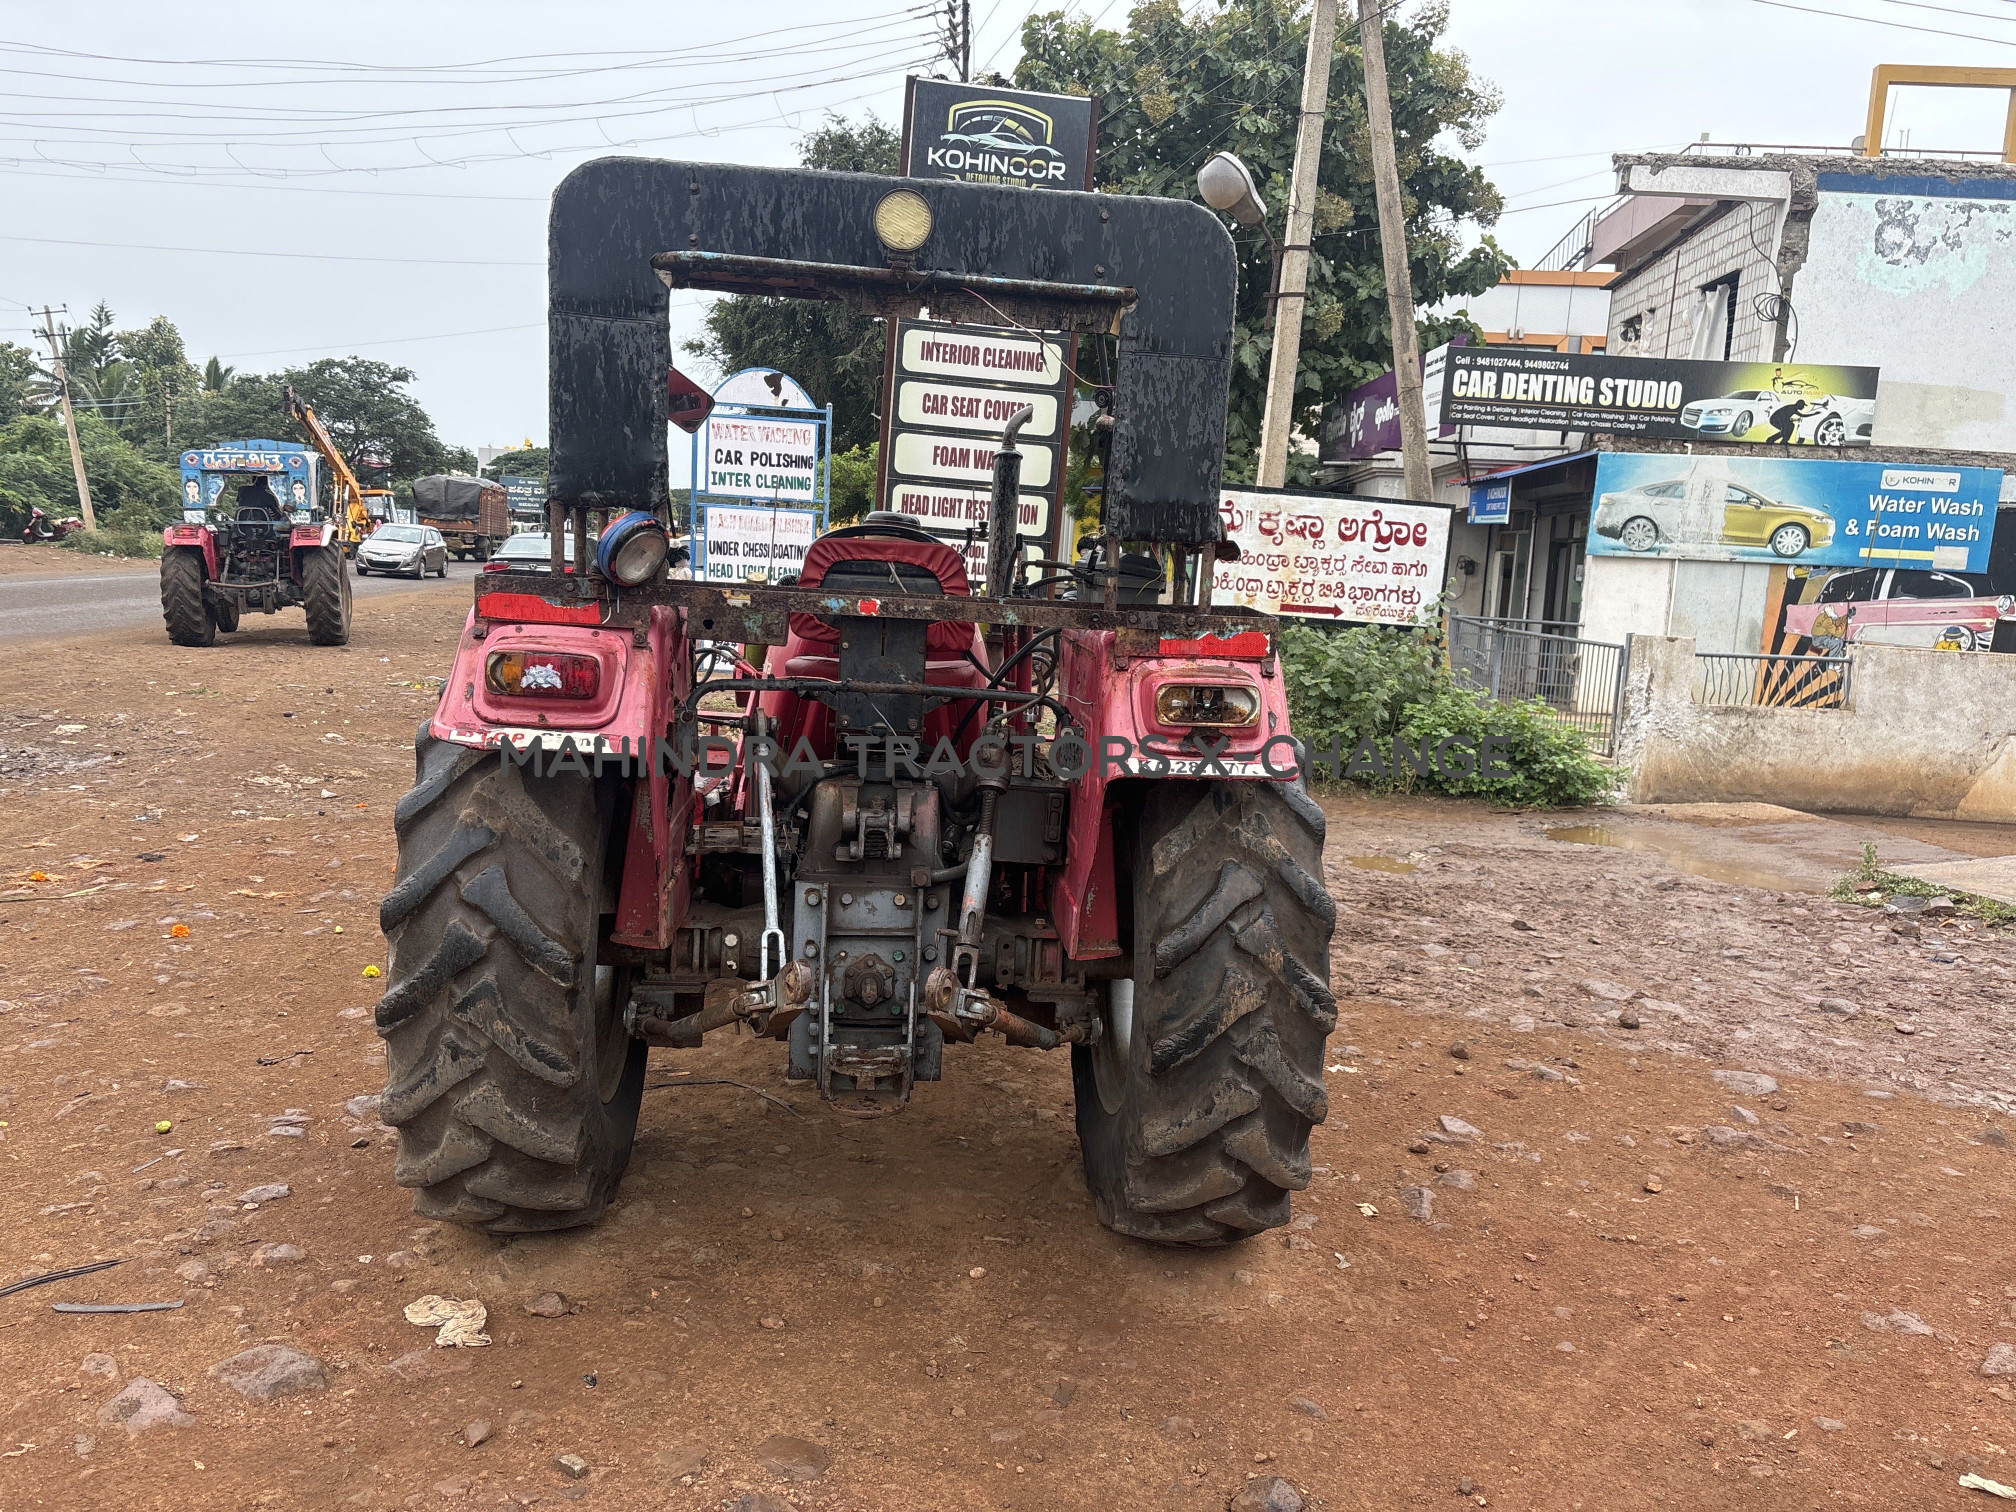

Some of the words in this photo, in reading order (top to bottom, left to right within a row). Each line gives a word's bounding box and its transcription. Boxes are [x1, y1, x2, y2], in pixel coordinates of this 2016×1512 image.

[927, 147, 1066, 181] KOHINOOR
[920, 340, 979, 367] INTERIOR
[983, 347, 1044, 372] CLEANING
[1455, 355, 1470, 365] Cell
[1476, 357, 1523, 369] 9481027444,
[1524, 359, 1570, 371] 9449802744
[1452, 369, 1498, 399] CAR
[1500, 372, 1594, 405] DENTING
[1598, 378, 1683, 410] STUDIO
[922, 392, 948, 416] CAR
[951, 395, 982, 419] SEAT
[984, 398, 1033, 424] COVE
[1463, 404, 1485, 413] Painting
[1492, 406, 1517, 415] Detailing
[1520, 407, 1540, 415] Interior
[1540, 408, 1567, 417] Cleaning
[1583, 411, 1600, 419] Foam
[1600, 412, 1625, 421] Washing
[1650, 415, 1676, 424] Polishing
[1463, 412, 1475, 420] Seat
[1475, 413, 1496, 421] Covers
[1498, 414, 1510, 422] Car
[1510, 415, 1538, 424] Headlight
[1538, 417, 1570, 426] Restoration
[1611, 421, 1636, 430] Coating
[711, 422, 756, 442] WATER
[757, 425, 812, 446] WASHING
[714, 448, 743, 466] CAR
[750, 451, 814, 470] POLISHING
[932, 445, 970, 469] FOAM
[711, 471, 751, 488] INTER
[755, 473, 812, 492] CLEANING
[901, 493, 930, 516] HEAD
[932, 495, 963, 519] LIGHT
[965, 498, 1039, 526] RESTION
[1868, 494, 1926, 514] Water
[1931, 496, 1984, 516] Wash
[1844, 518, 1860, 536] &
[1865, 519, 1920, 539] Foam
[1926, 522, 1980, 542] Wash
[708, 540, 739, 557] UNDER
[950, 543, 985, 559] SCOOL
[1219, 549, 1290, 572] ಹಿಂದ್ರಾ
[708, 562, 733, 579] HEAD
[767, 566, 802, 582] CLEANIN
